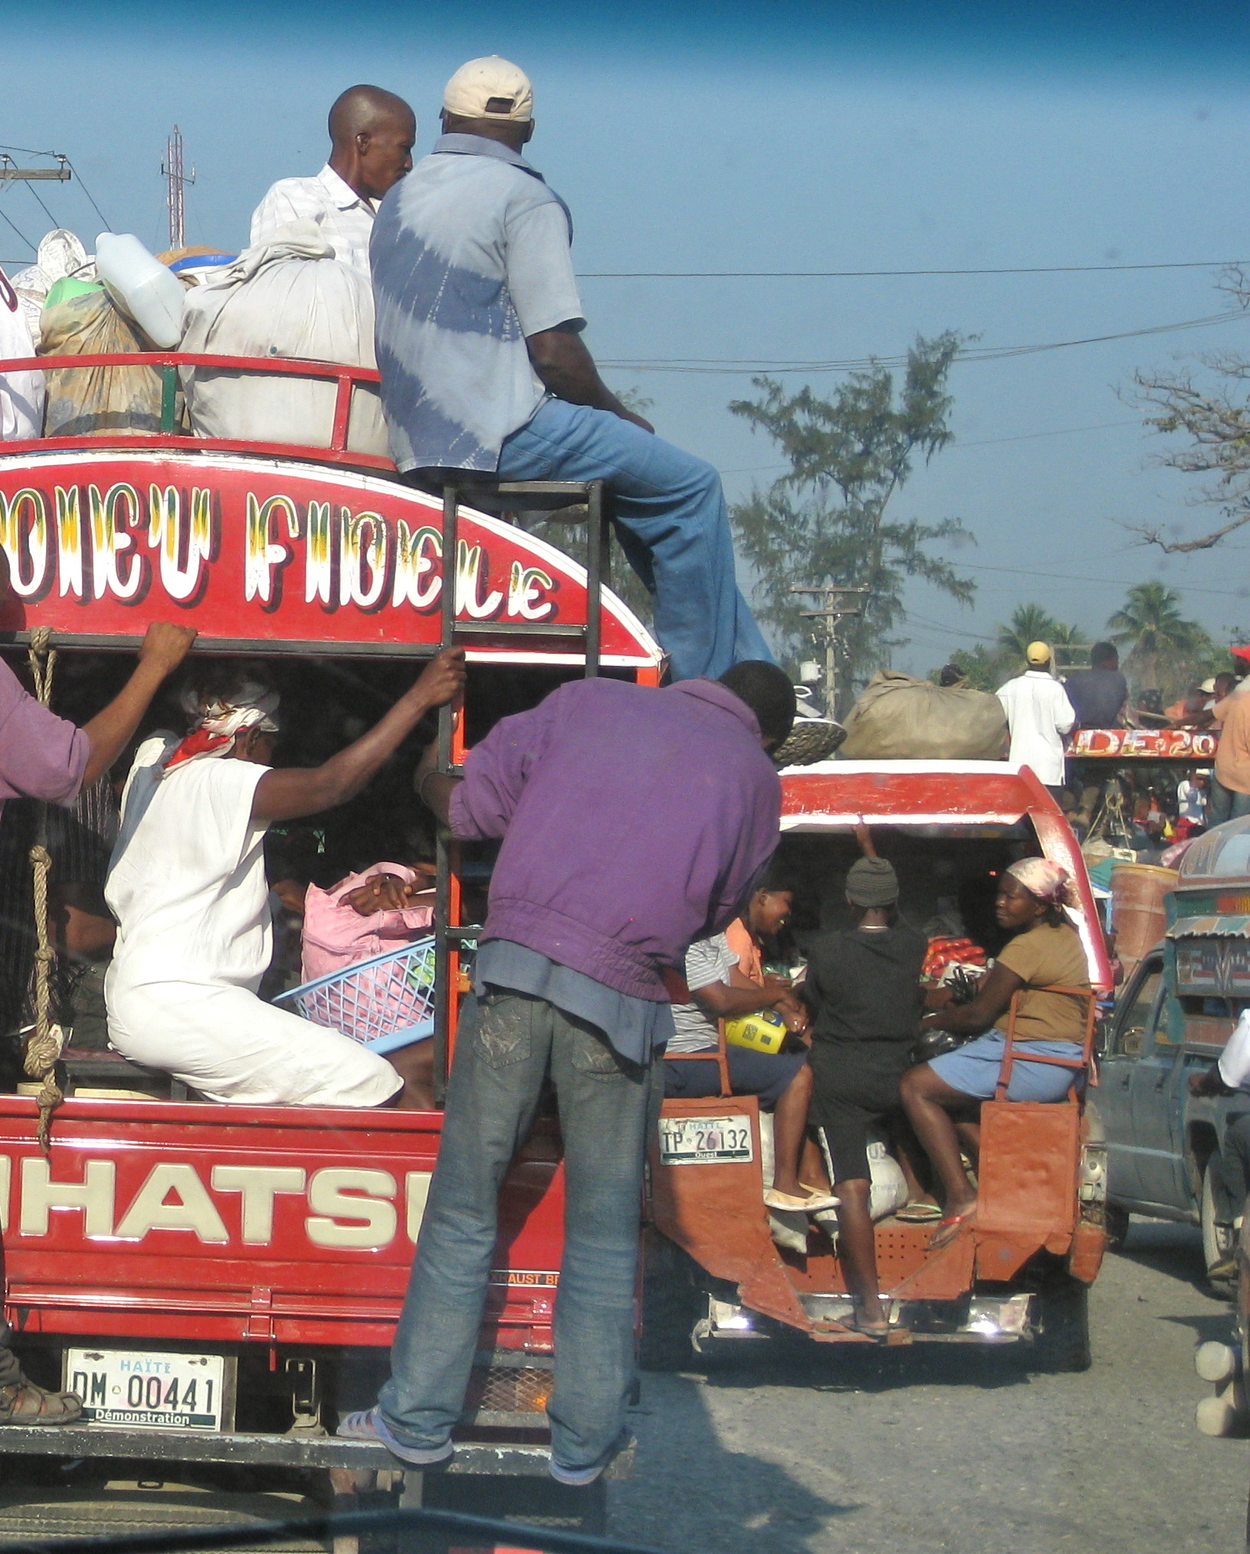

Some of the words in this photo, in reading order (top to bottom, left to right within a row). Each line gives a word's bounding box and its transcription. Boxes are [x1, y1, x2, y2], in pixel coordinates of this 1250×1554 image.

[244, 491, 553, 620] FIDELE
[662, 1132, 683, 1152] TP
[695, 1129, 748, 1150] 26132
[695, 1151, 718, 1159] Ouest
[73, 1371, 107, 1406] DM
[128, 1374, 214, 1413] 00441
[95, 1408, 190, 1425] Démonstration
